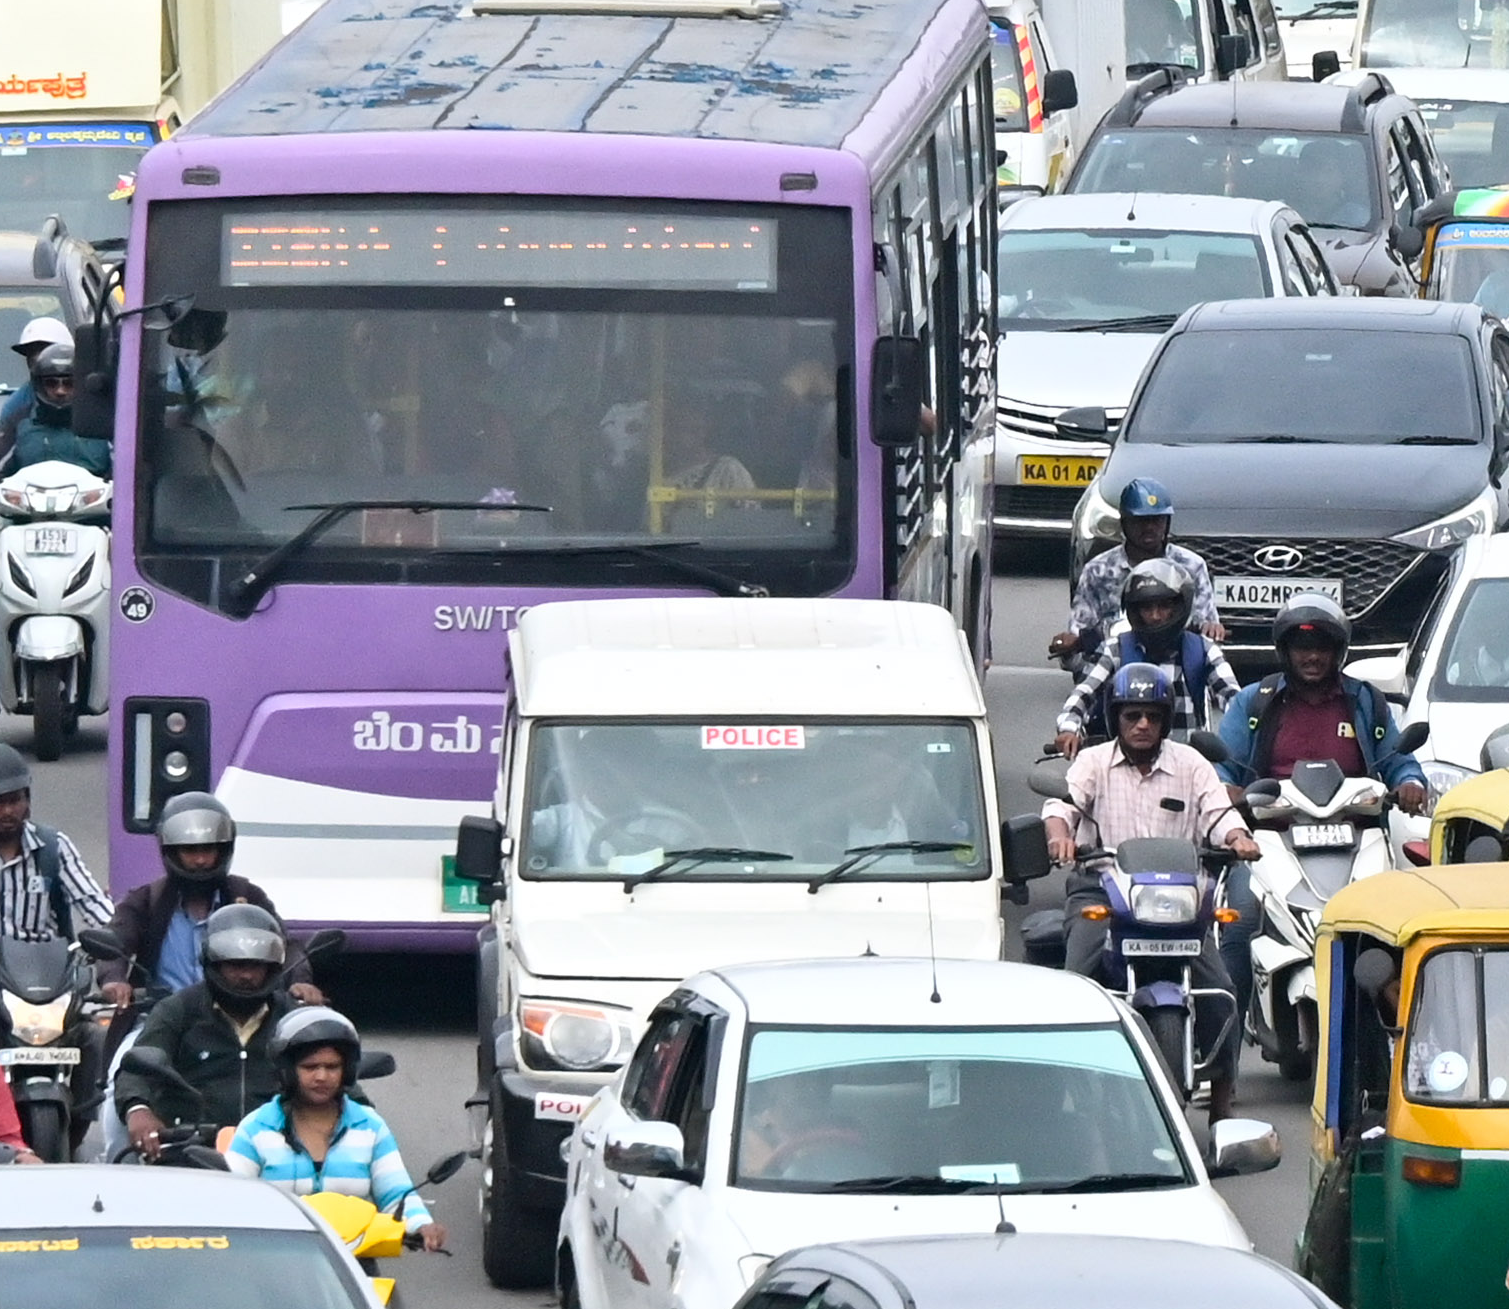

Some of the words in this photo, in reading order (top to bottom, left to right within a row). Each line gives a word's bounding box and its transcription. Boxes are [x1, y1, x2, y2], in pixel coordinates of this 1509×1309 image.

[1024, 464, 1047, 481] KA
[1051, 465, 1070, 482] 01
[1075, 465, 1098, 482] AD
[126, 602, 148, 618] 49
[705, 727, 799, 746] POLICE
[130, 1235, 230, 1250] ಸರ್ಕಾರ
